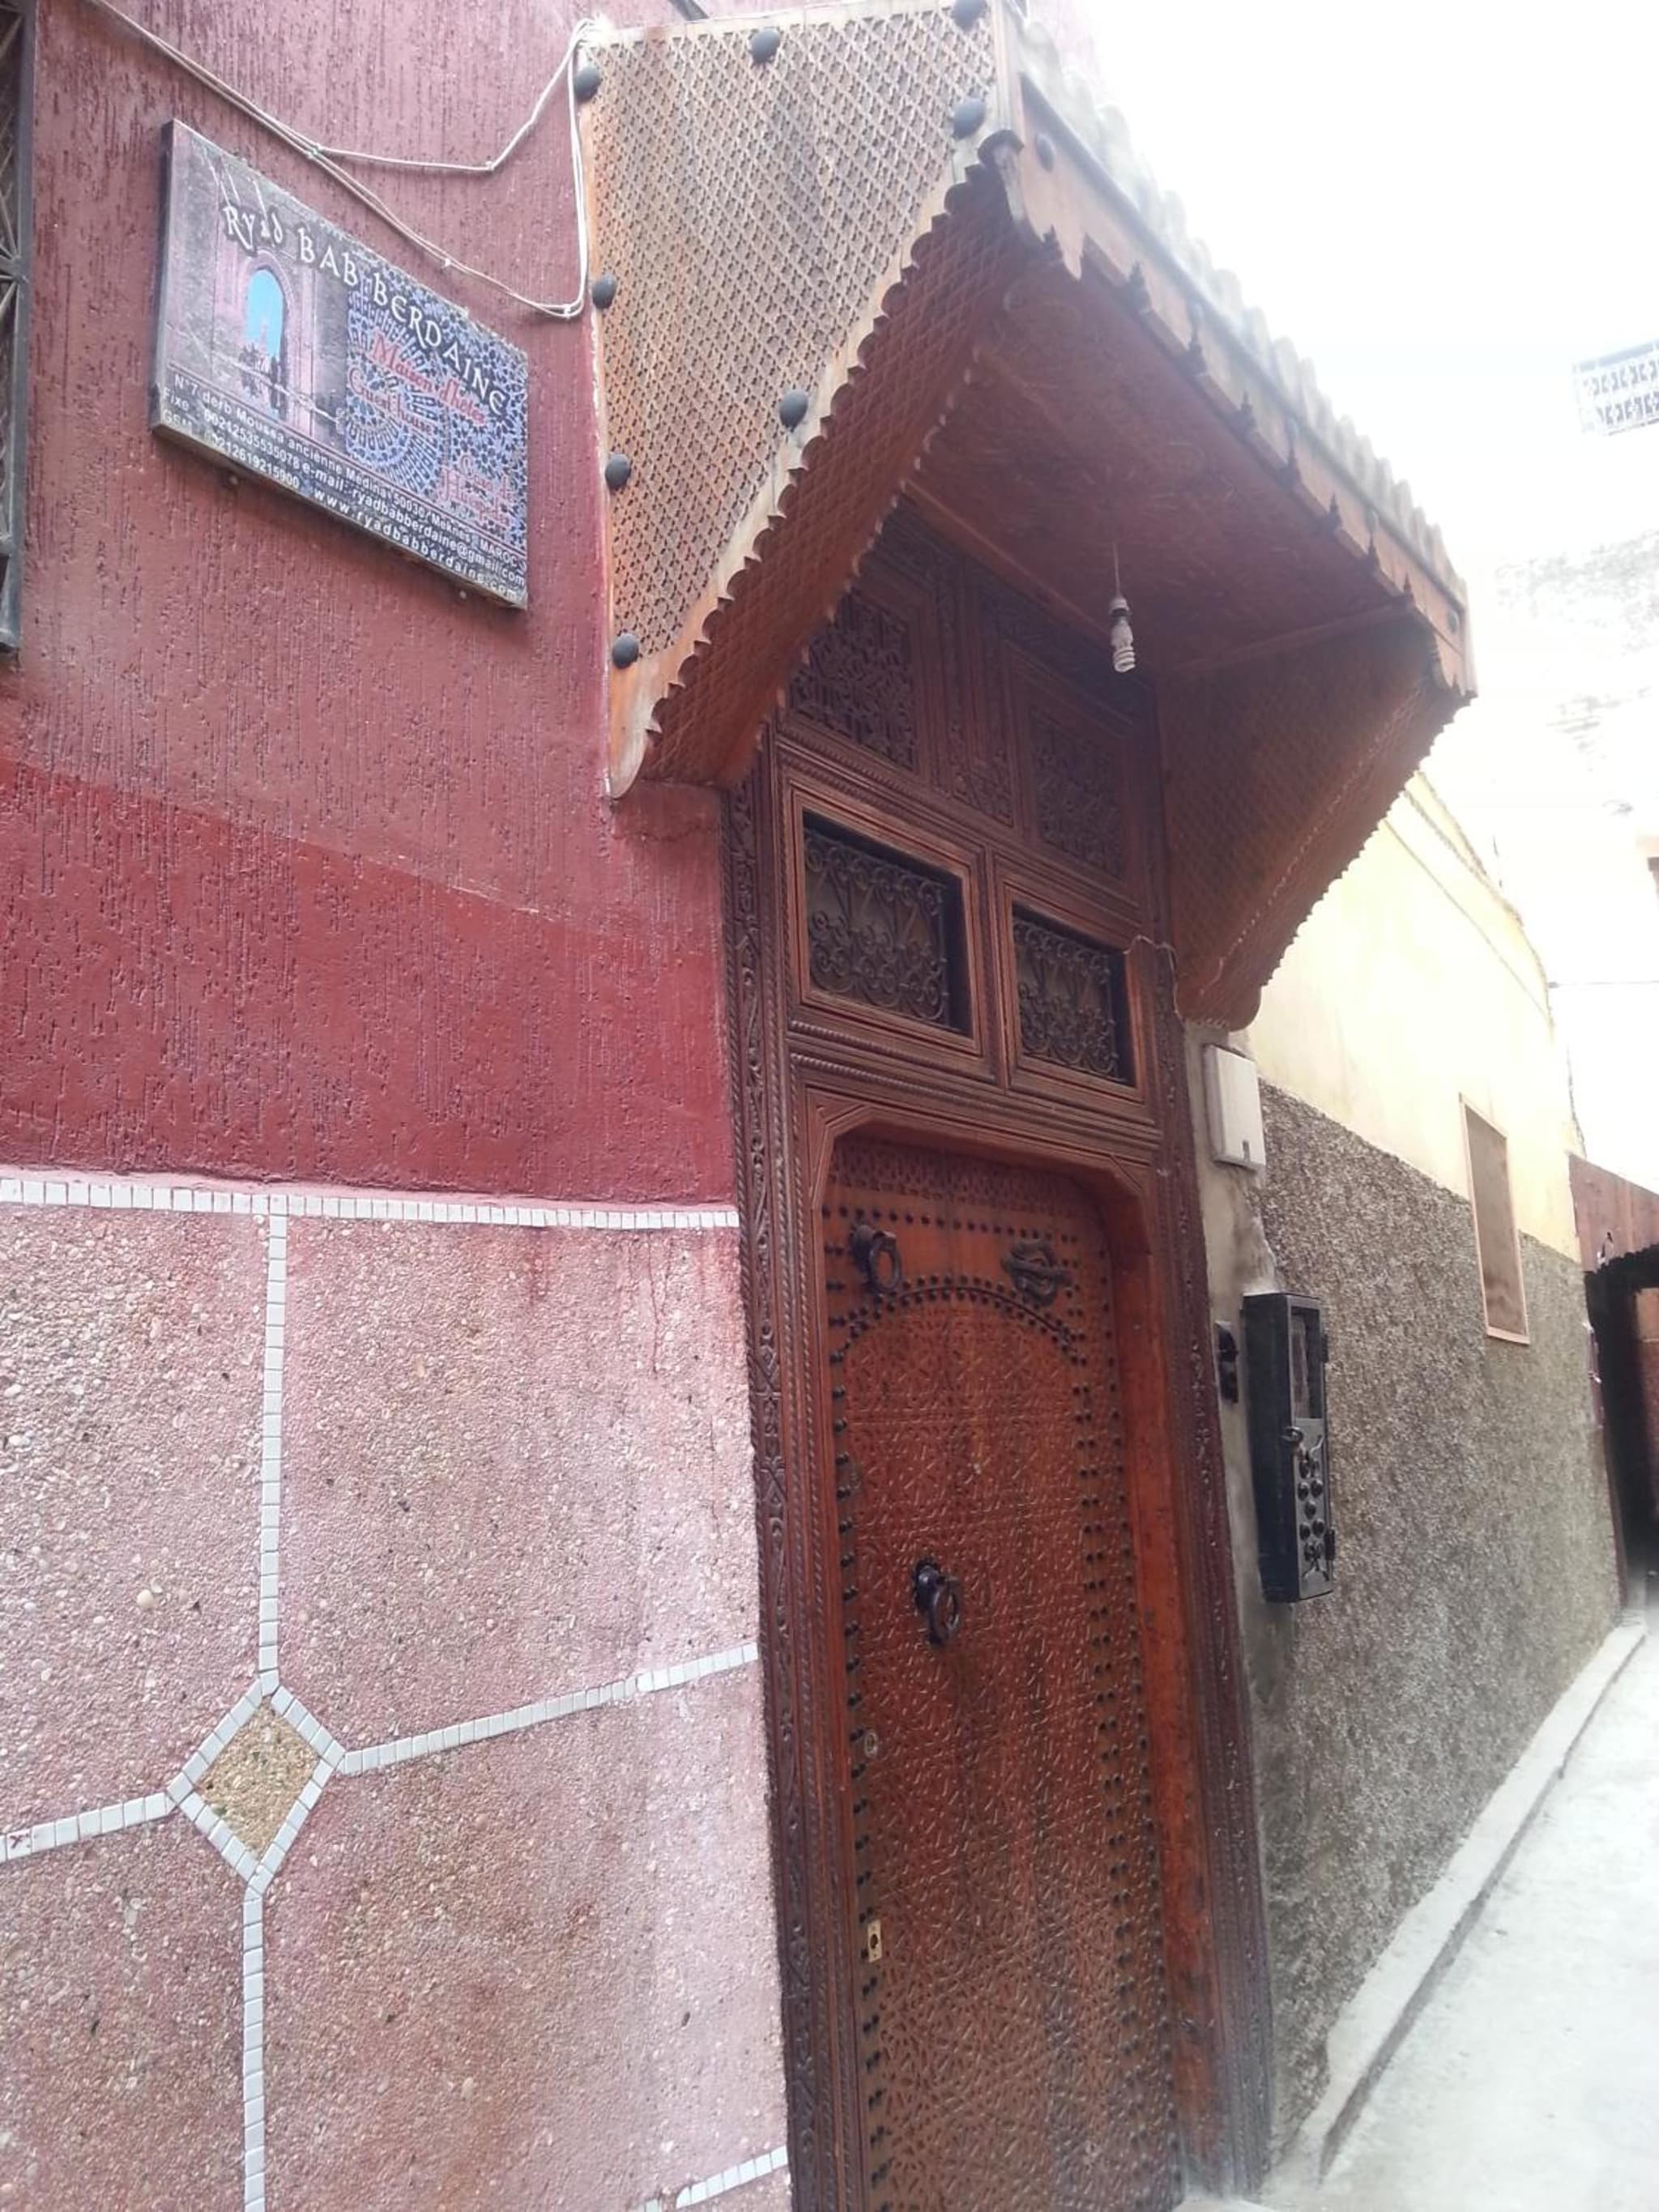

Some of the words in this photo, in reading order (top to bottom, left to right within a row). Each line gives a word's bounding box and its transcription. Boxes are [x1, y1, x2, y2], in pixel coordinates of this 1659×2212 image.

[223, 205, 284, 249] Ryad
[301, 230, 359, 287] BAB
[373, 276, 505, 413] BERDAINE
[372, 331, 433, 393] Maison
[396, 393, 432, 437] house
[202, 388, 232, 416] derb
[237, 406, 284, 443] Moussa
[480, 538, 518, 569] MAROC
